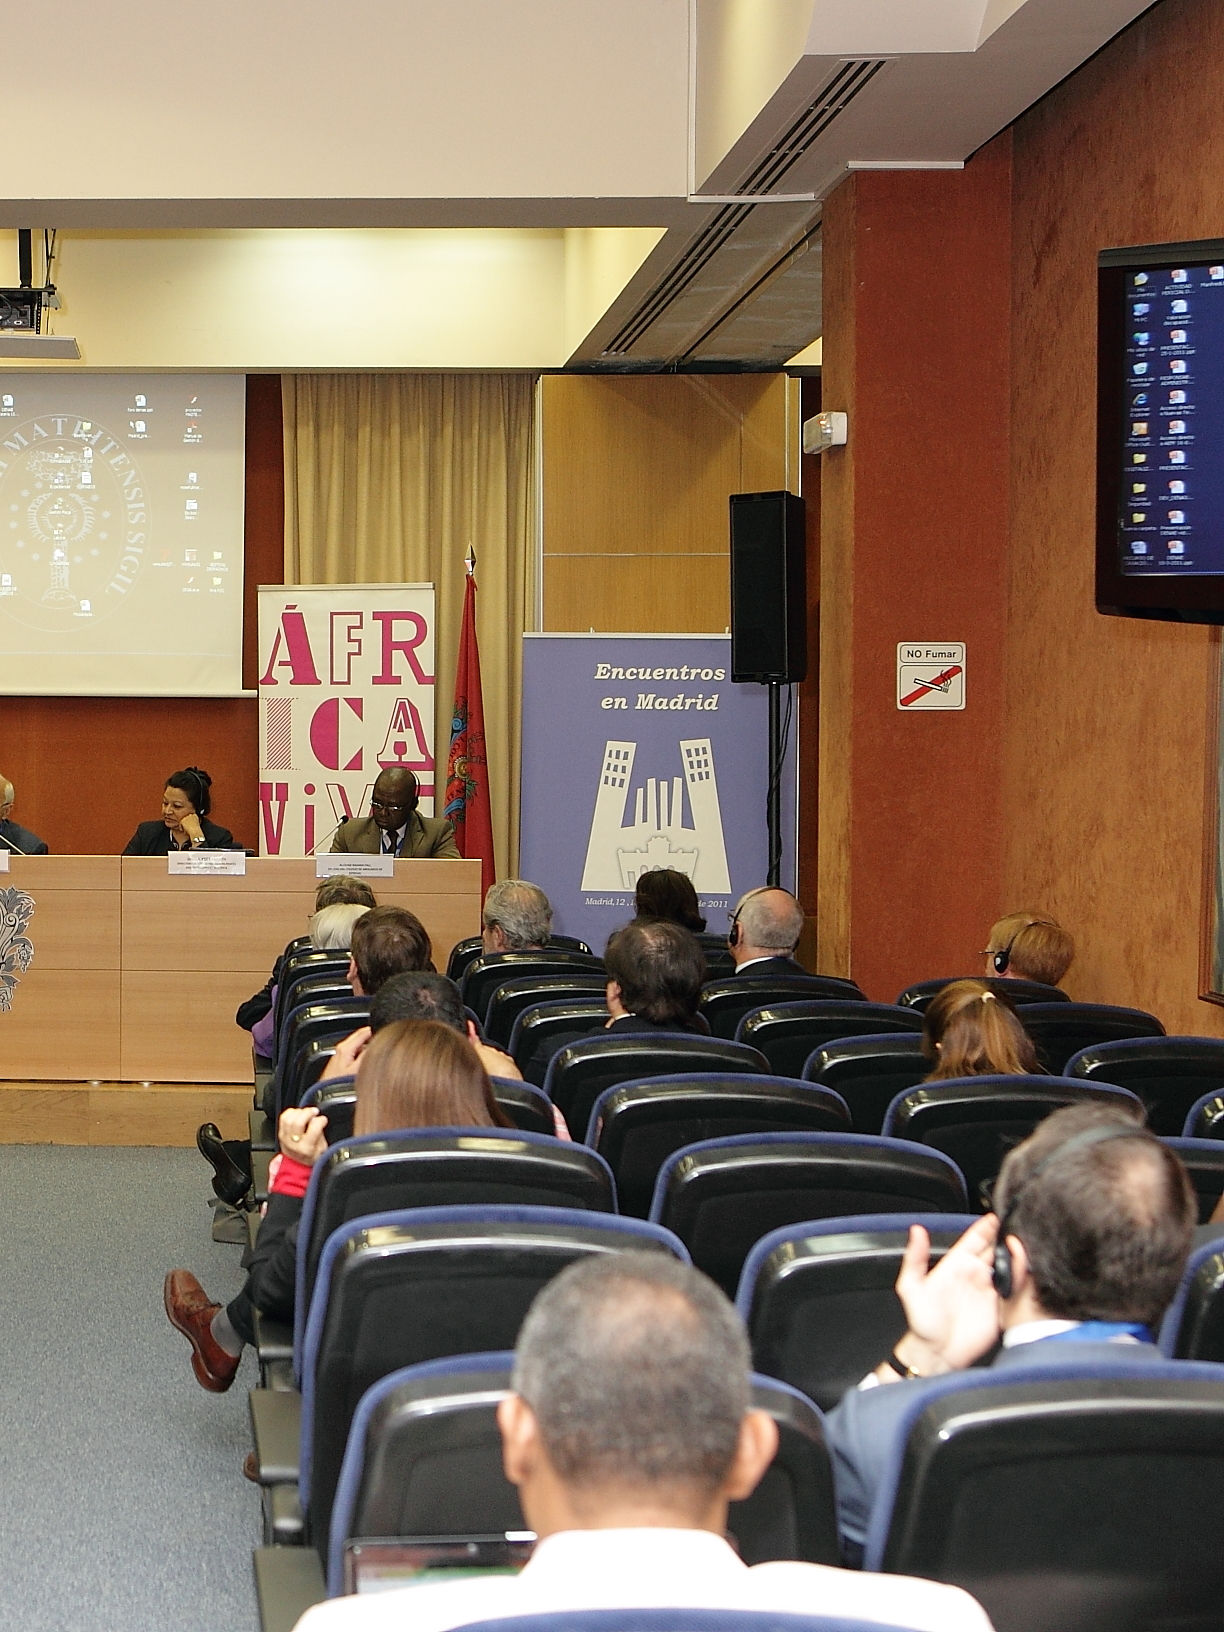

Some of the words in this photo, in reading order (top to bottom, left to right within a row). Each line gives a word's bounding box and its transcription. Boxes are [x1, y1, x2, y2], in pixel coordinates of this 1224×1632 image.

[907, 650, 922, 658] NO
[925, 650, 957, 659] Fumar
[594, 663, 726, 681] Encuentros
[601, 697, 628, 710] en
[635, 693, 719, 711] Madrid
[707, 900, 728, 908] 2011
